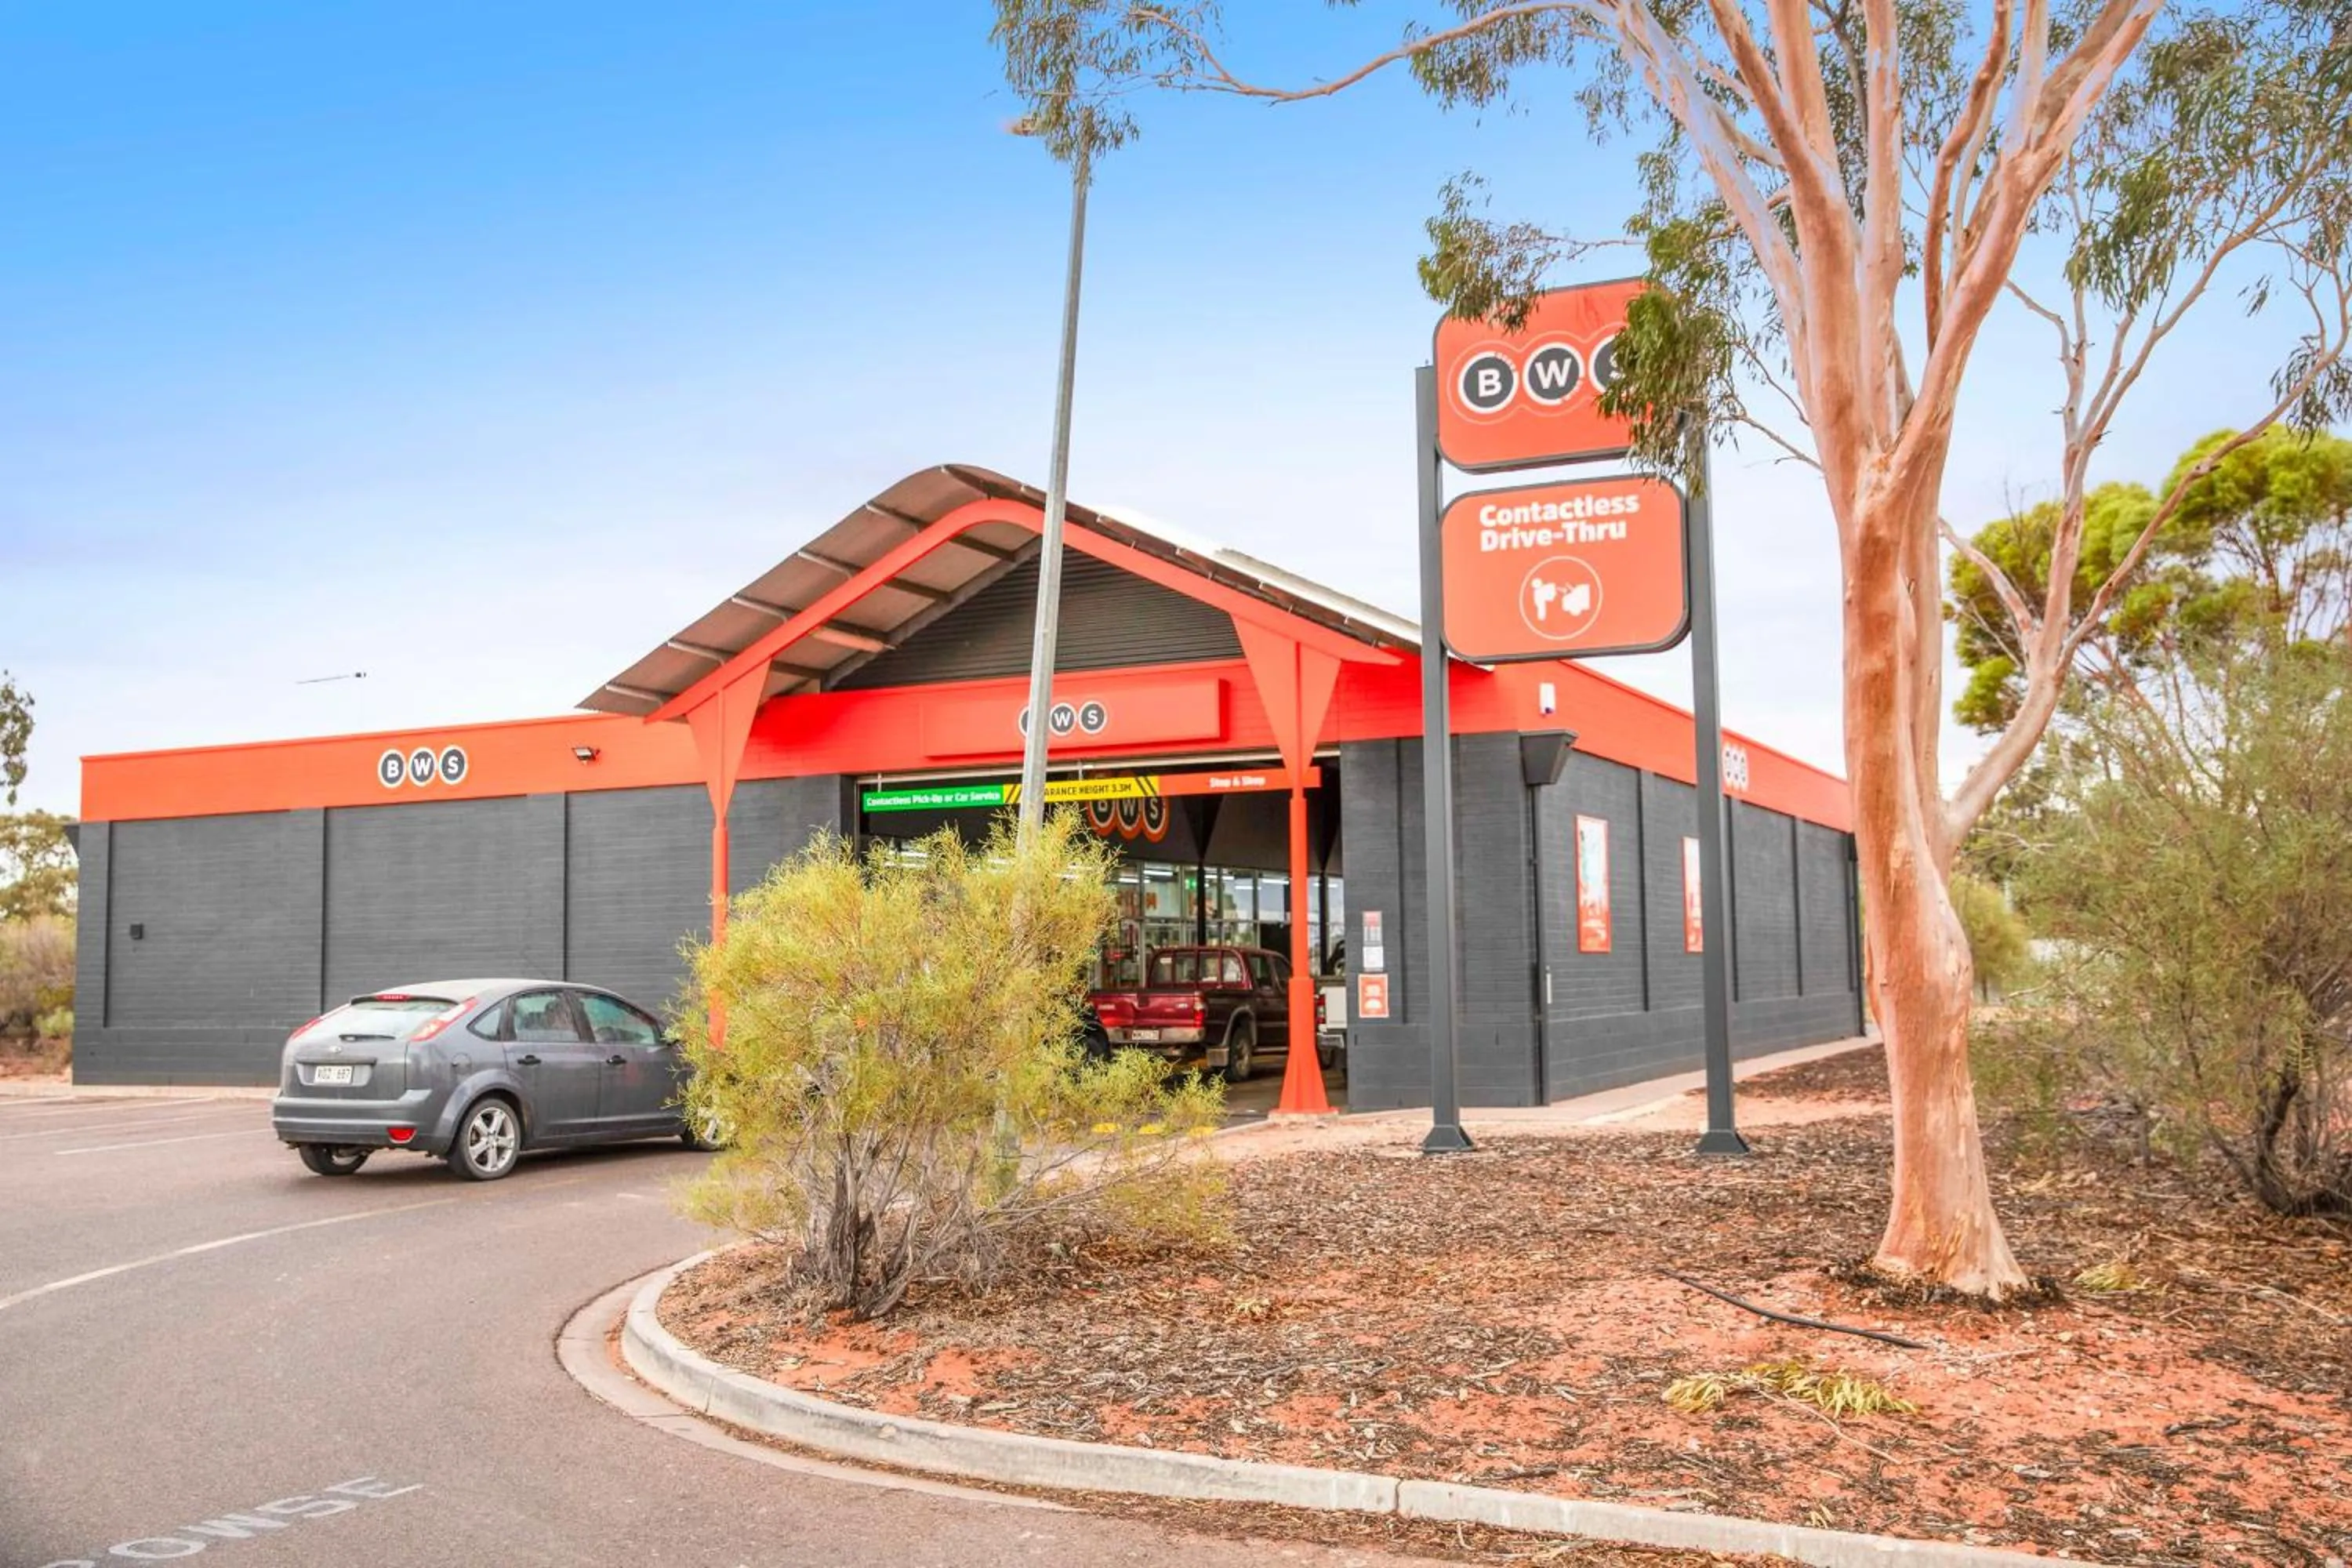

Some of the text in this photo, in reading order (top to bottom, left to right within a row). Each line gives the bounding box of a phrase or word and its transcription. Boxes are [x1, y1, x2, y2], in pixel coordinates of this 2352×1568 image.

[1479, 494, 1639, 526] Contactless
[1480, 519, 1627, 552] Drive-Thru
[387, 756, 459, 779] BWS
[1044, 783, 1131, 797] ARANCE HEIGHT 3.3M
[38, 1476, 424, 1568] OWSE
